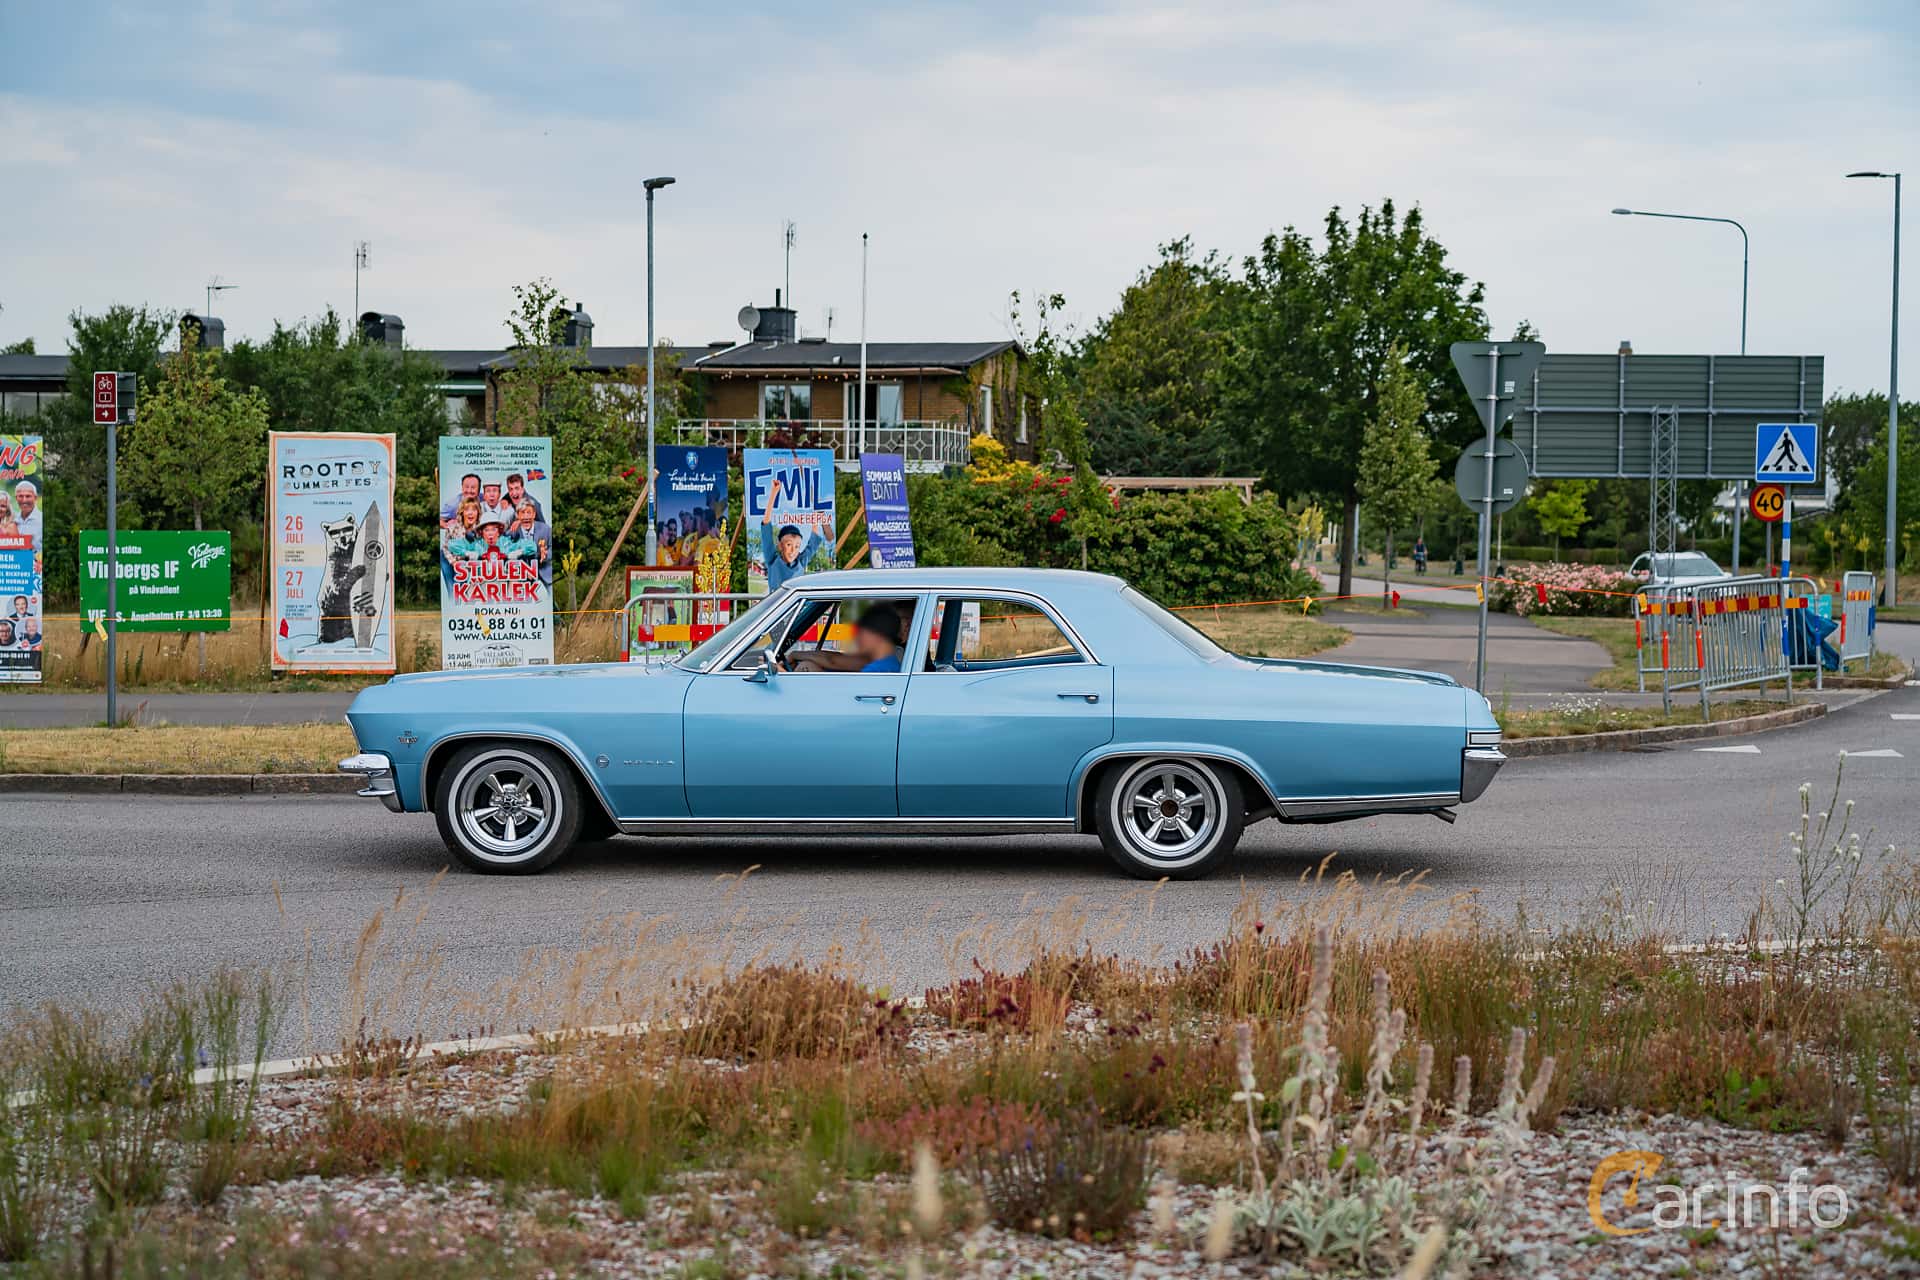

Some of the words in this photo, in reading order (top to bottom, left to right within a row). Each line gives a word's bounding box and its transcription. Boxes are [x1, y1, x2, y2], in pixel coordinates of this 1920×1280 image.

[283, 461, 381, 478] ROOTSY
[866, 470, 892, 481] SOMMAR
[749, 468, 832, 515] EMIL
[1756, 493, 1784, 512] 40
[285, 515, 303, 531] 26
[285, 532, 304, 544] JULI
[87, 546, 104, 554] Kom
[164, 560, 180, 578] IF
[453, 560, 538, 582] STULEN
[285, 570, 303, 586] 27
[128, 584, 139, 595] på
[286, 588, 304, 599] JULI
[453, 577, 539, 603] KÄRLEK
[87, 609, 106, 622] VIF
[202, 608, 223, 618] 13:30
[474, 607, 501, 616] BOKA
[448, 618, 482, 631] 0346
[488, 617, 505, 630] 88
[510, 617, 525, 630] 61
[530, 617, 545, 629] 01
